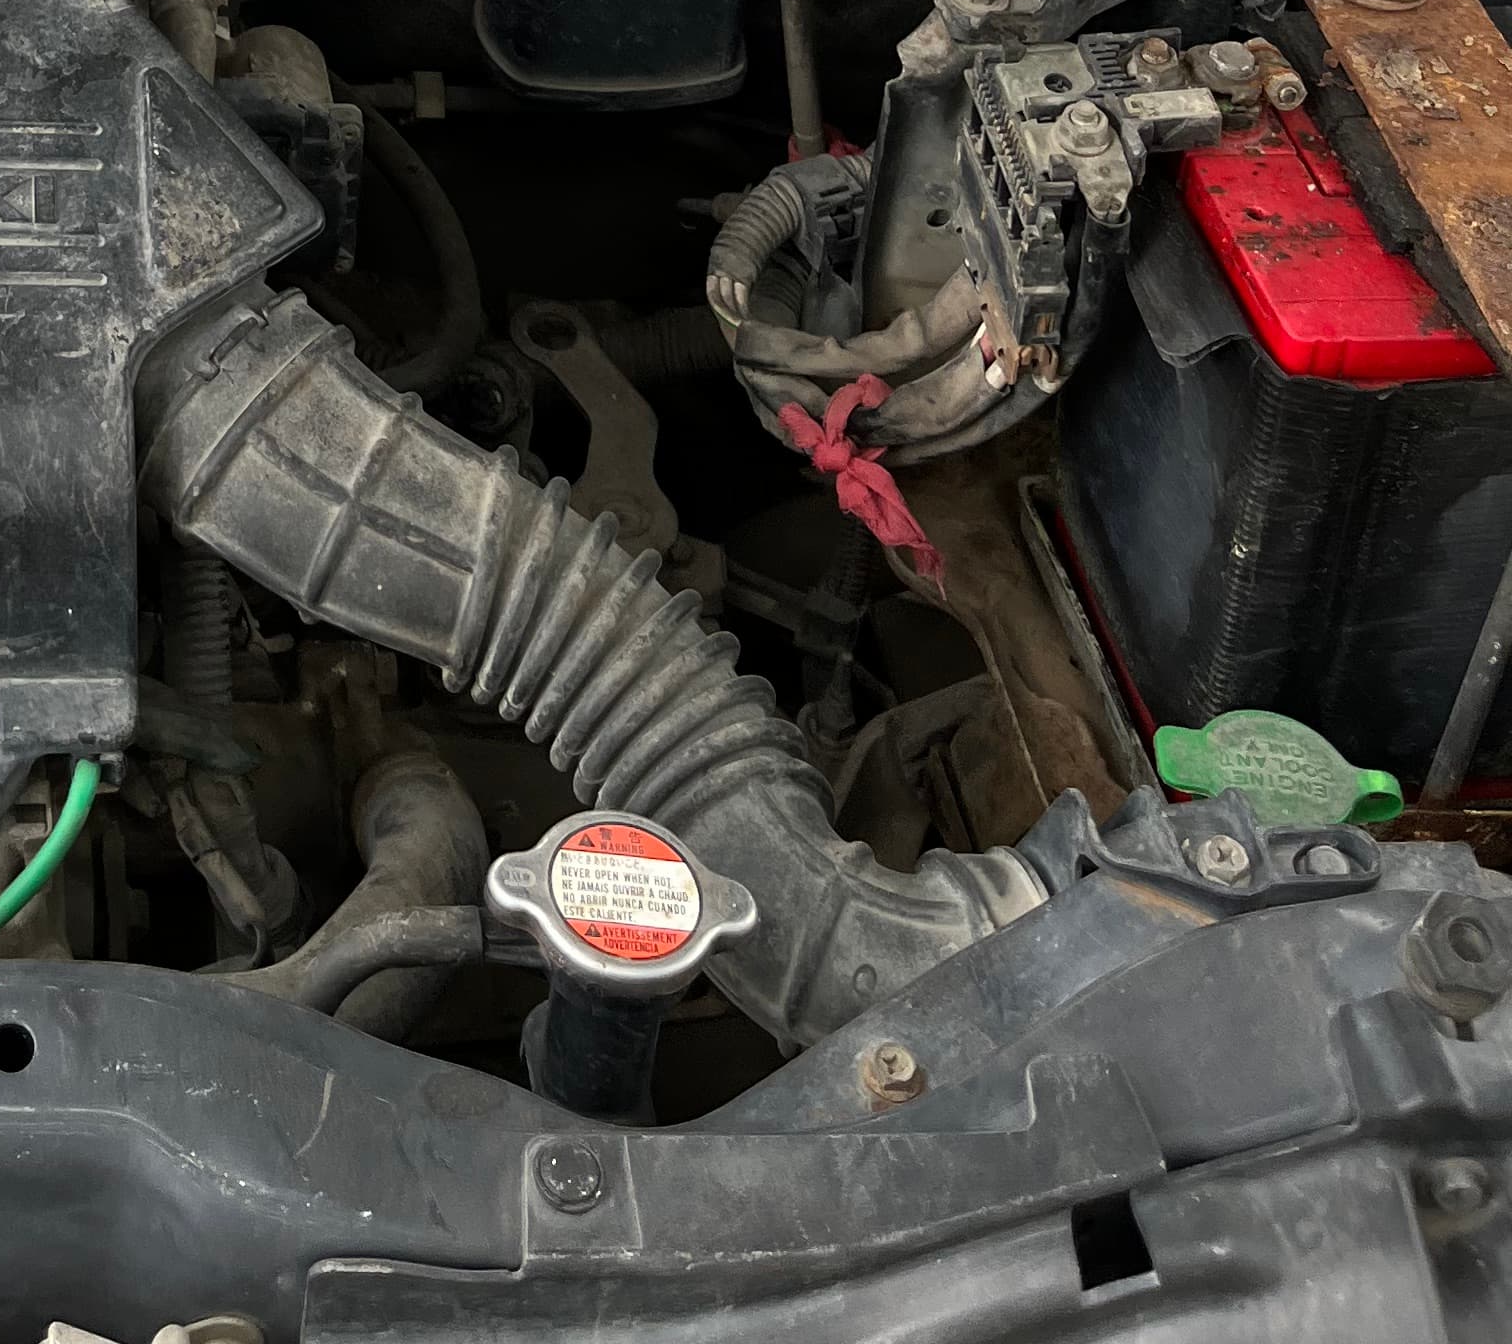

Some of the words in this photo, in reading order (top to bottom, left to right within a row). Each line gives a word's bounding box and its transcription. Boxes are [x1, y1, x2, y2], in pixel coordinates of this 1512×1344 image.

[1218, 750, 1336, 782] COOLANT
[1230, 768, 1329, 800] ENGINE
[600, 842, 645, 855] WARNING
[561, 866, 591, 879] NEVER
[595, 869, 619, 881] OPEN
[624, 873, 650, 885] WHEN
[562, 879, 573, 891] NE
[577, 880, 609, 895] JAMAIS
[613, 884, 645, 898] OUVRIR
[563, 891, 576, 904] NO
[580, 893, 608, 907] ABRIR
[612, 896, 644, 910] NUNCA
[648, 900, 687, 916] CUANDO
[564, 904, 586, 918] ESTE
[602, 926, 679, 945] AVERTISSEMENT
[602, 937, 660, 954] ADVERTENCIA
